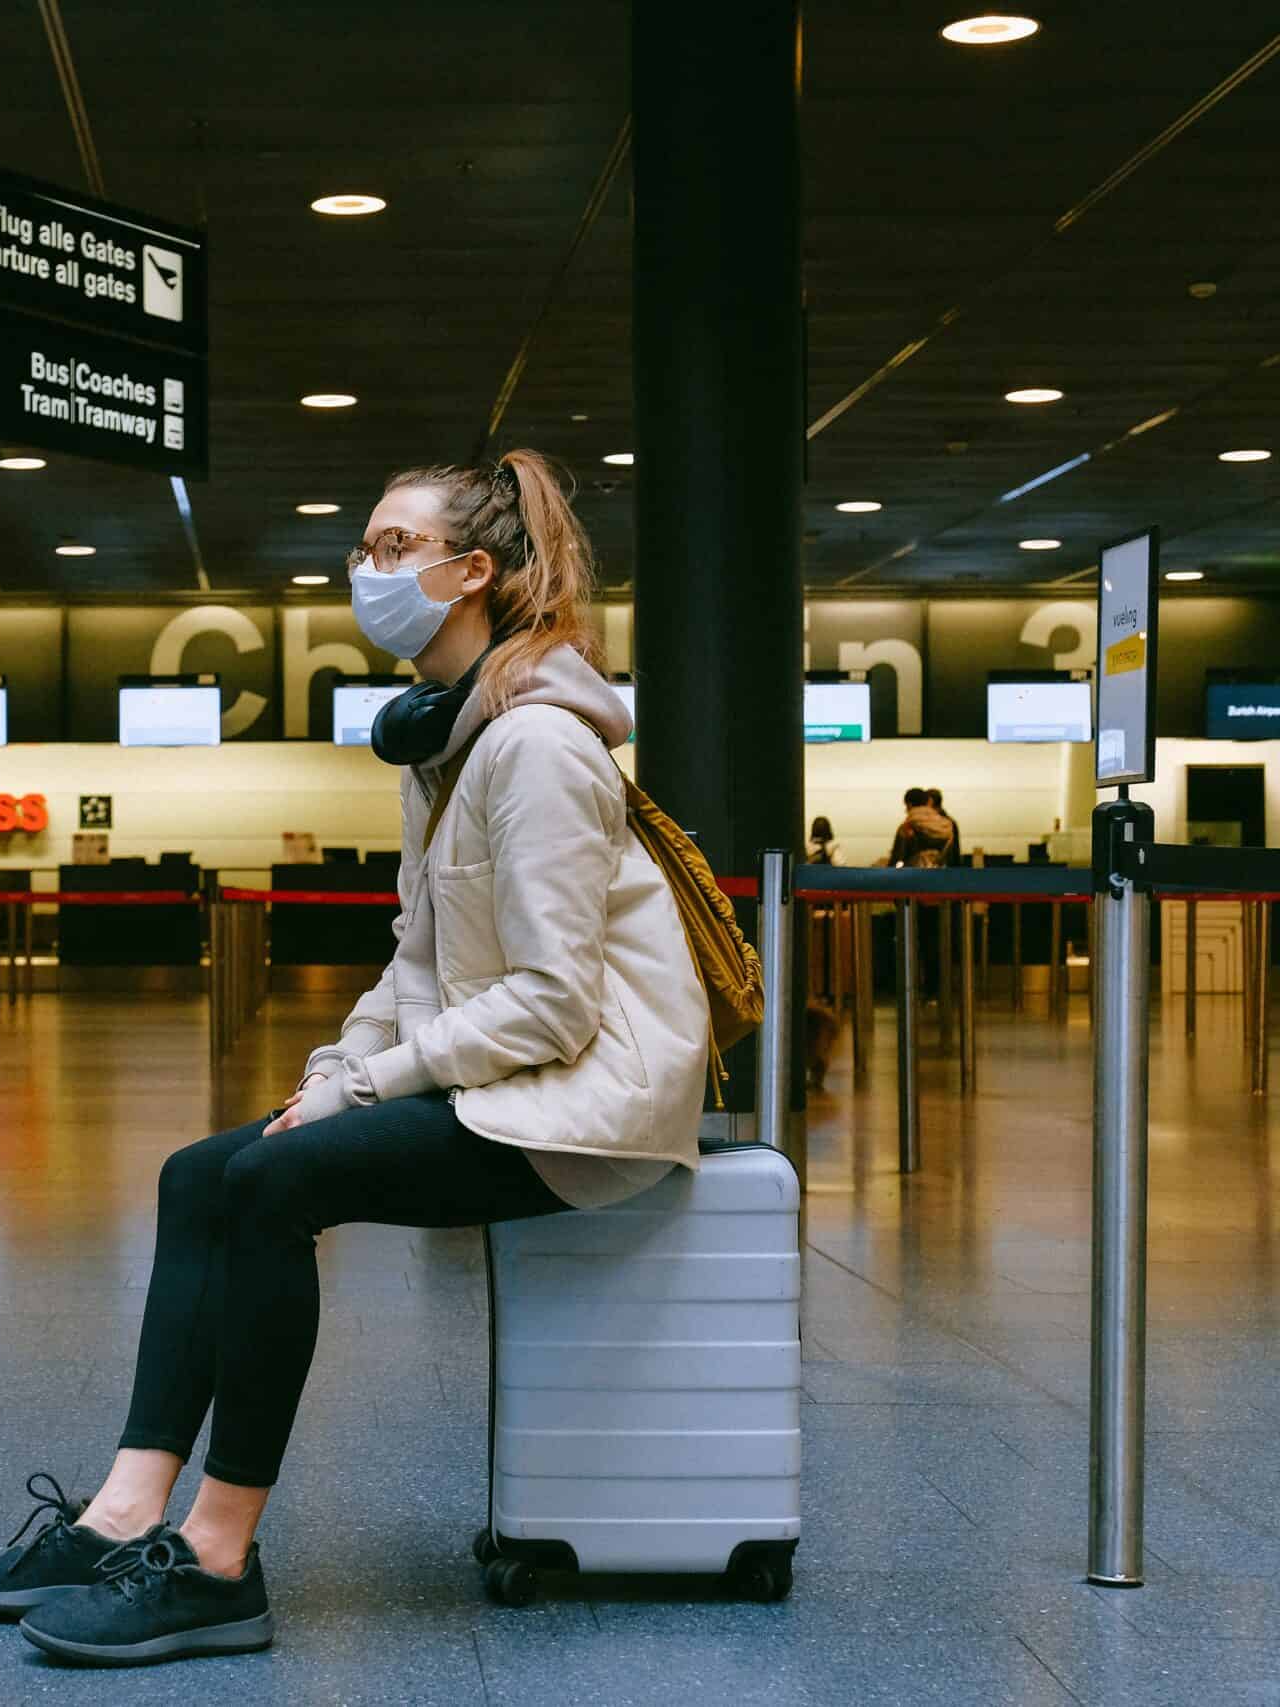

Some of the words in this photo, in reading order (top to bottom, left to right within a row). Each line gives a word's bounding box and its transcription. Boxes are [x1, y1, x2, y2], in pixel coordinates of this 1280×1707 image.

[38, 221, 75, 253] alle
[80, 231, 136, 271] Gates
[55, 260, 79, 288] all
[83, 272, 137, 304] gates
